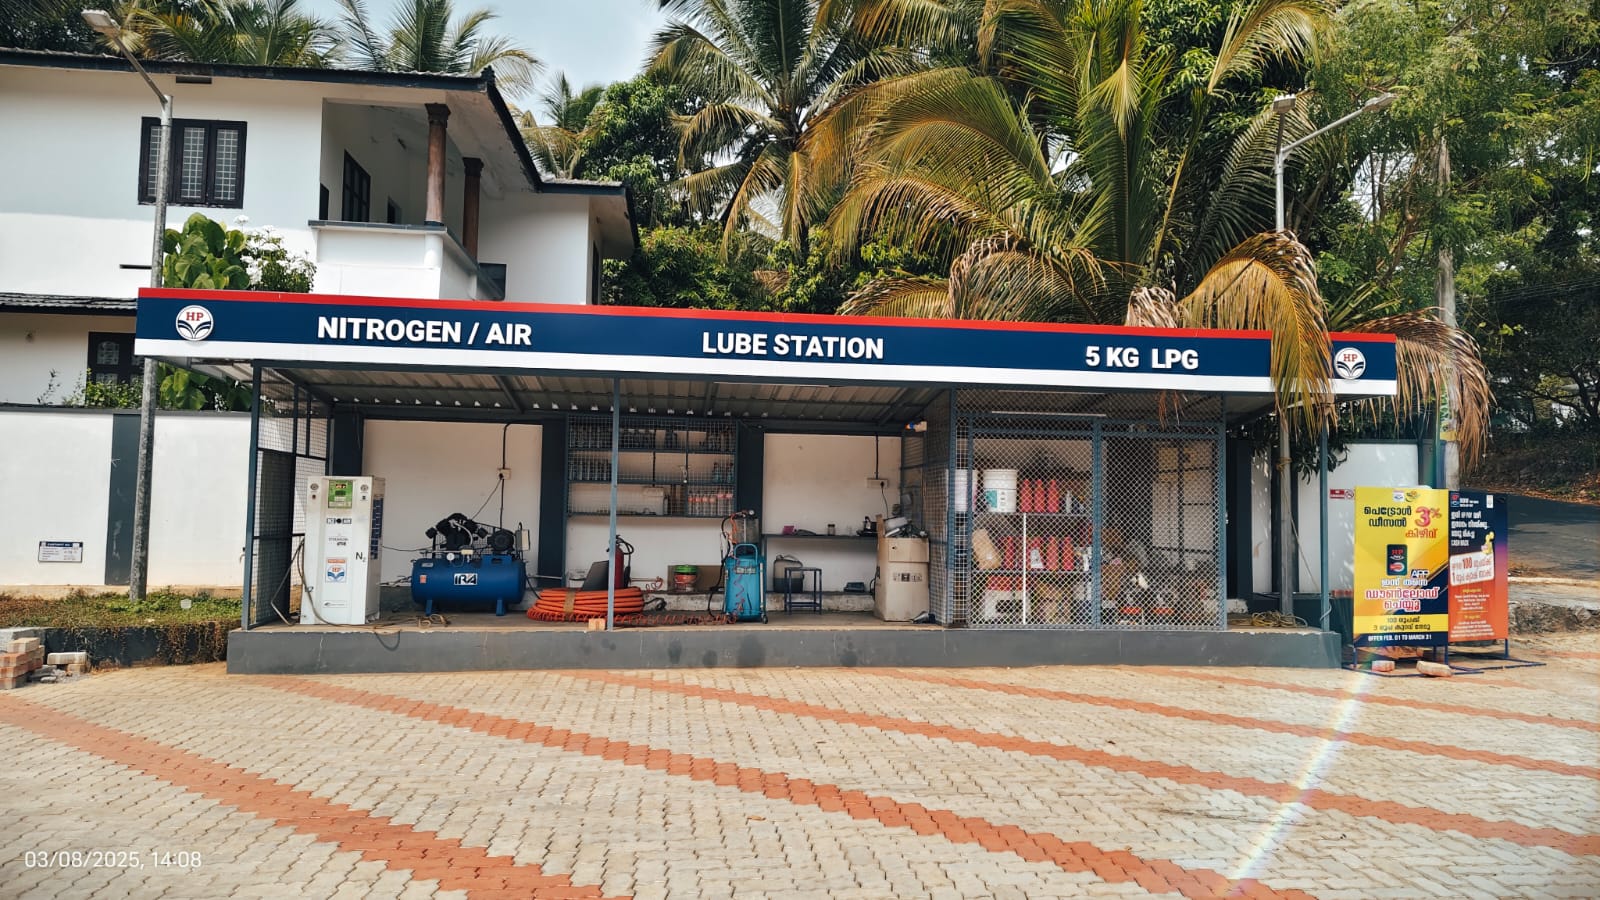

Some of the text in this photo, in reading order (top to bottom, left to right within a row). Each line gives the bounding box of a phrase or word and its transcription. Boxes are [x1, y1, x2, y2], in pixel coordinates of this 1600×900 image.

[186, 311, 204, 321] HP
[317, 315, 532, 346] NITROGEN / AIR
[702, 331, 884, 360] LUBE STATION
[1343, 353, 1358, 362] HP
[1085, 346, 1199, 370] 5 KG LPG
